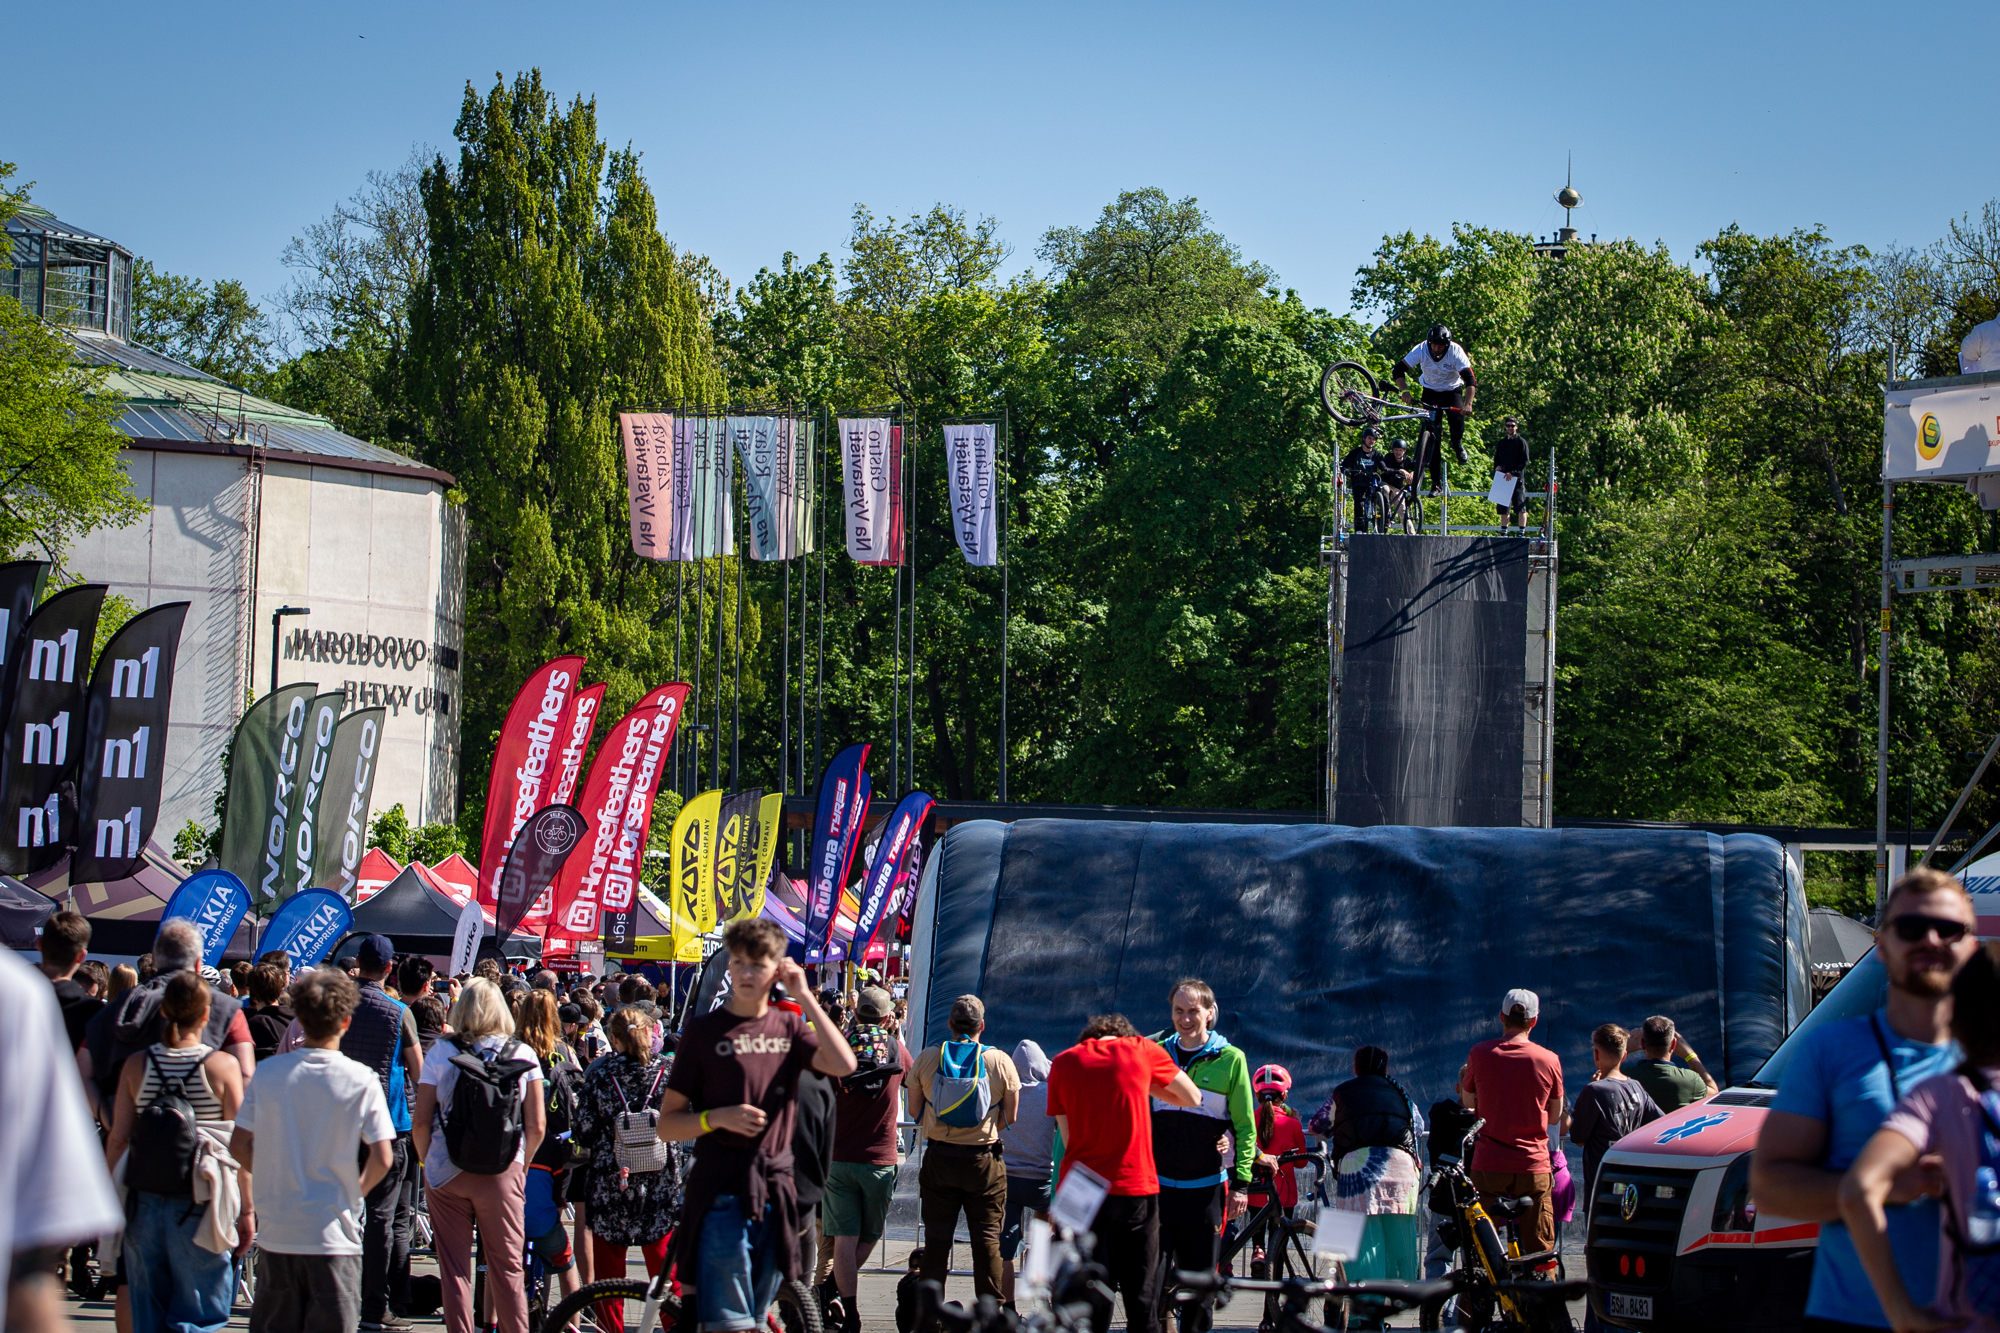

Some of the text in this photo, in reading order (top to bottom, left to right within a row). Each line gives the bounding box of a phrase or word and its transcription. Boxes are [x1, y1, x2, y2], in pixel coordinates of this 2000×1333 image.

[29, 628, 79, 683] n1
[110, 646, 160, 698] n1
[294, 628, 427, 662] MAROLDOVO
[22, 711, 70, 766] n1
[101, 725, 150, 779] n1
[17, 792, 59, 848] n1
[261, 695, 306, 899] NORCO
[296, 705, 334, 893] NORCO
[338, 718, 377, 904] NORCO
[577, 717, 649, 899] Horsefeathers
[95, 806, 142, 858] n1
[702, 818, 711, 860] COMPANY
[741, 814, 751, 853] COMPANY
[761, 820, 771, 858] COMPANY
[814, 780, 847, 919] Rubena TYRES
[858, 862, 893, 933] Rubena
[888, 814, 910, 862] TYRES
[198, 885, 234, 941] AKIA
[207, 902, 238, 949] SURPRISE
[286, 903, 340, 959] VAKIA
[306, 921, 340, 960] SURPRISE
[715, 1033, 793, 1057] adidas
[1611, 1295, 1649, 1317] 5SH 8483
